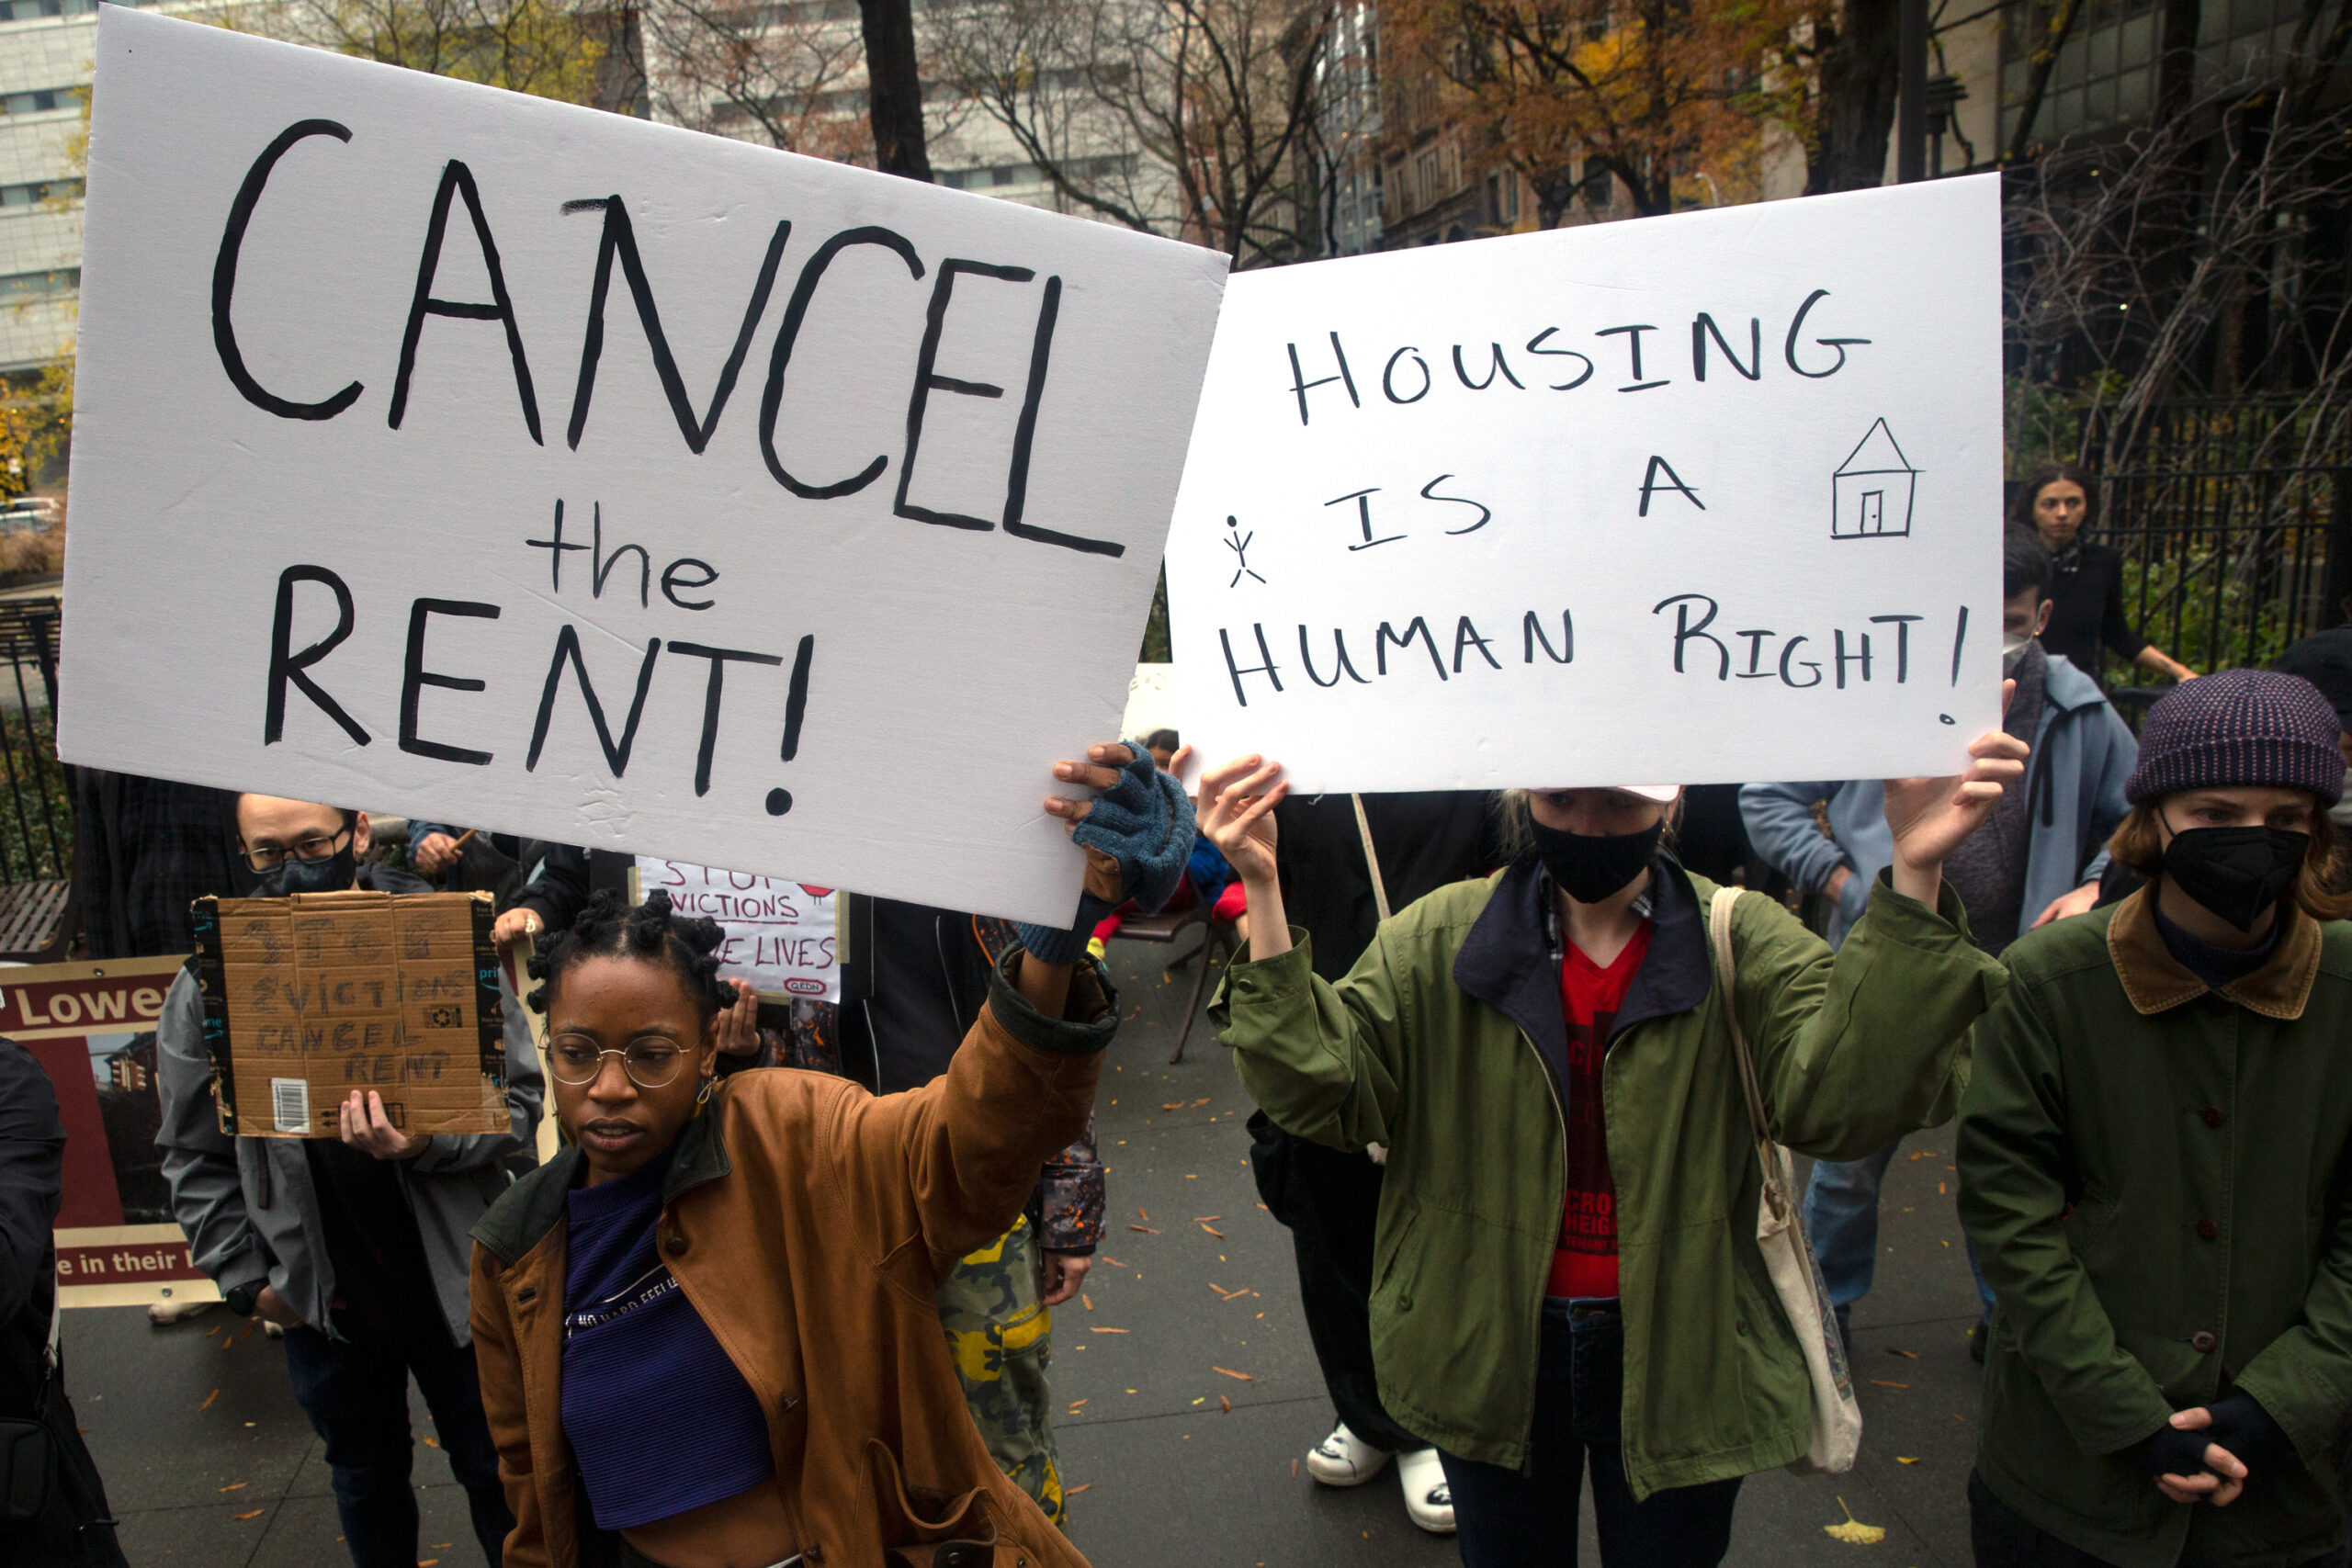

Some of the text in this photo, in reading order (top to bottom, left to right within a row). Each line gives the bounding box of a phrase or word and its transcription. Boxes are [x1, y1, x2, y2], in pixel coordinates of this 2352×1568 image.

[209, 118, 1126, 558] CANCEL
[1287, 289, 1872, 426] HOUSING
[1324, 455, 1706, 553] IS A
[525, 498, 720, 612] the
[1218, 593, 1969, 726] HUMAN RIGHT!
[264, 564, 817, 818] RENT!
[671, 891, 799, 918] VICTIONS
[755, 935, 836, 969] LIVES
[479, 967, 499, 981] pri
[14, 987, 172, 1027] Lowe
[256, 1021, 426, 1053] CANCEL
[344, 1052, 451, 1085] RENT
[1565, 1188, 1617, 1214] CRO
[1565, 1213, 1617, 1235] HEIG
[79, 1254, 106, 1274] in
[112, 1250, 177, 1272] their
